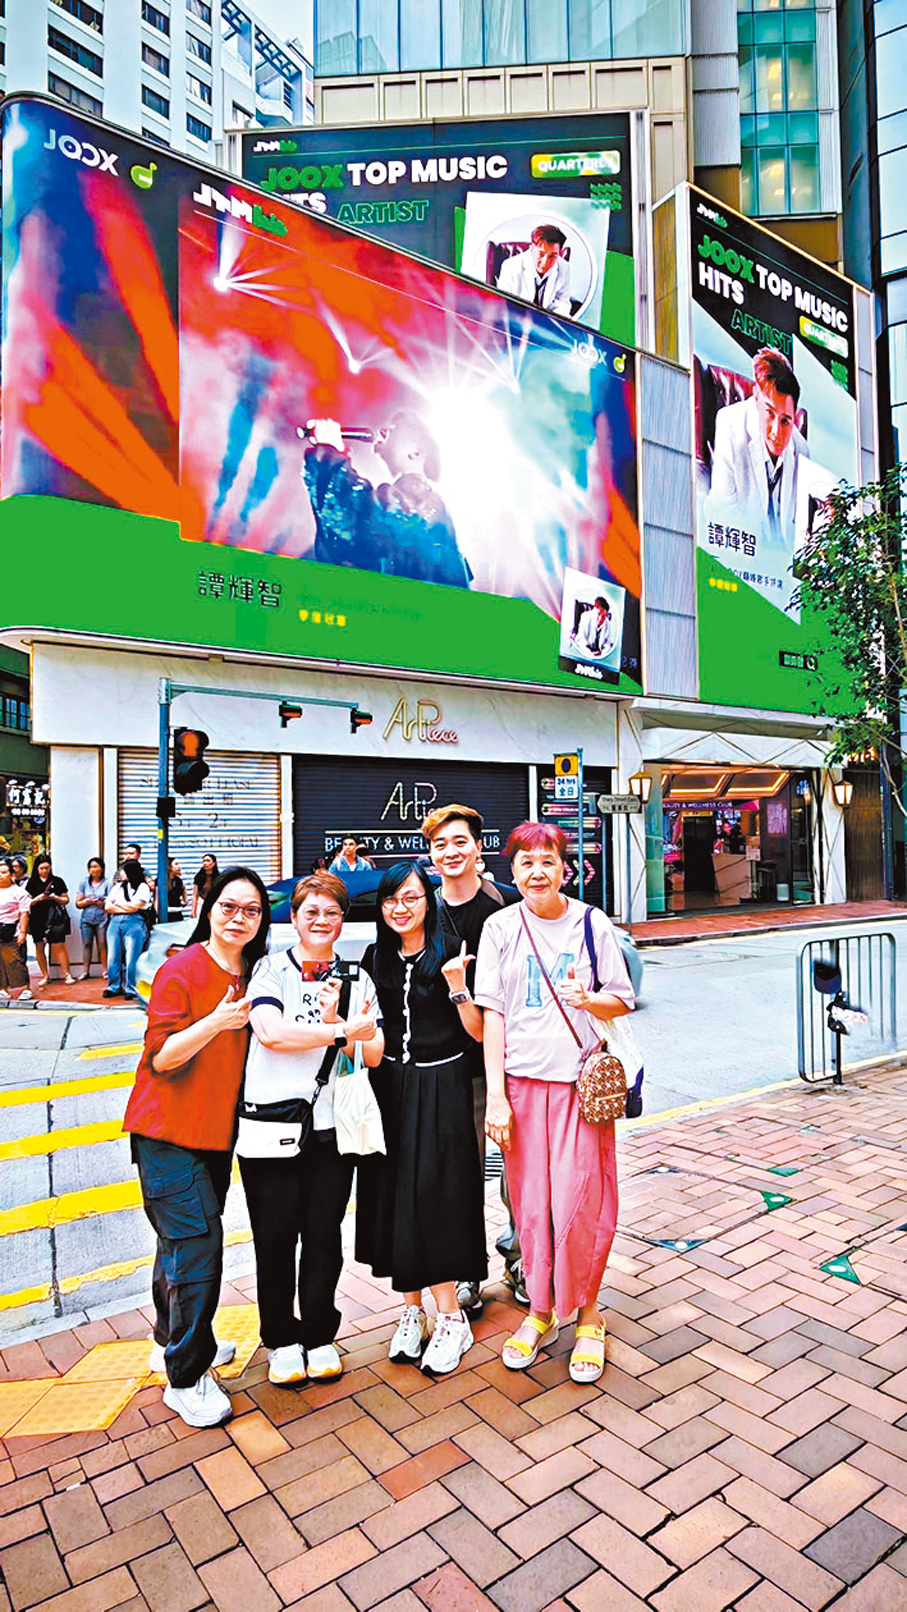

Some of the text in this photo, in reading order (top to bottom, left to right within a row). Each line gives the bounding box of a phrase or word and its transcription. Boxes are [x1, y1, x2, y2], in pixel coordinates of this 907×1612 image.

[43, 129, 120, 177] JOOX
[260, 154, 509, 192] JOOX TOP MUSIC
[337, 200, 429, 225] ARTIST
[698, 234, 849, 332] JOOX TOP MUSIC
[698, 261, 745, 306] HITS
[730, 308, 793, 355] ARTIST
[707, 521, 757, 557] 譚輝智
[198, 570, 282, 609] 譚輝智
[559, 786, 574, 796] 全日
[324, 836, 380, 851] BETY
[384, 837, 395, 850] &
[483, 834, 500, 849] UB
